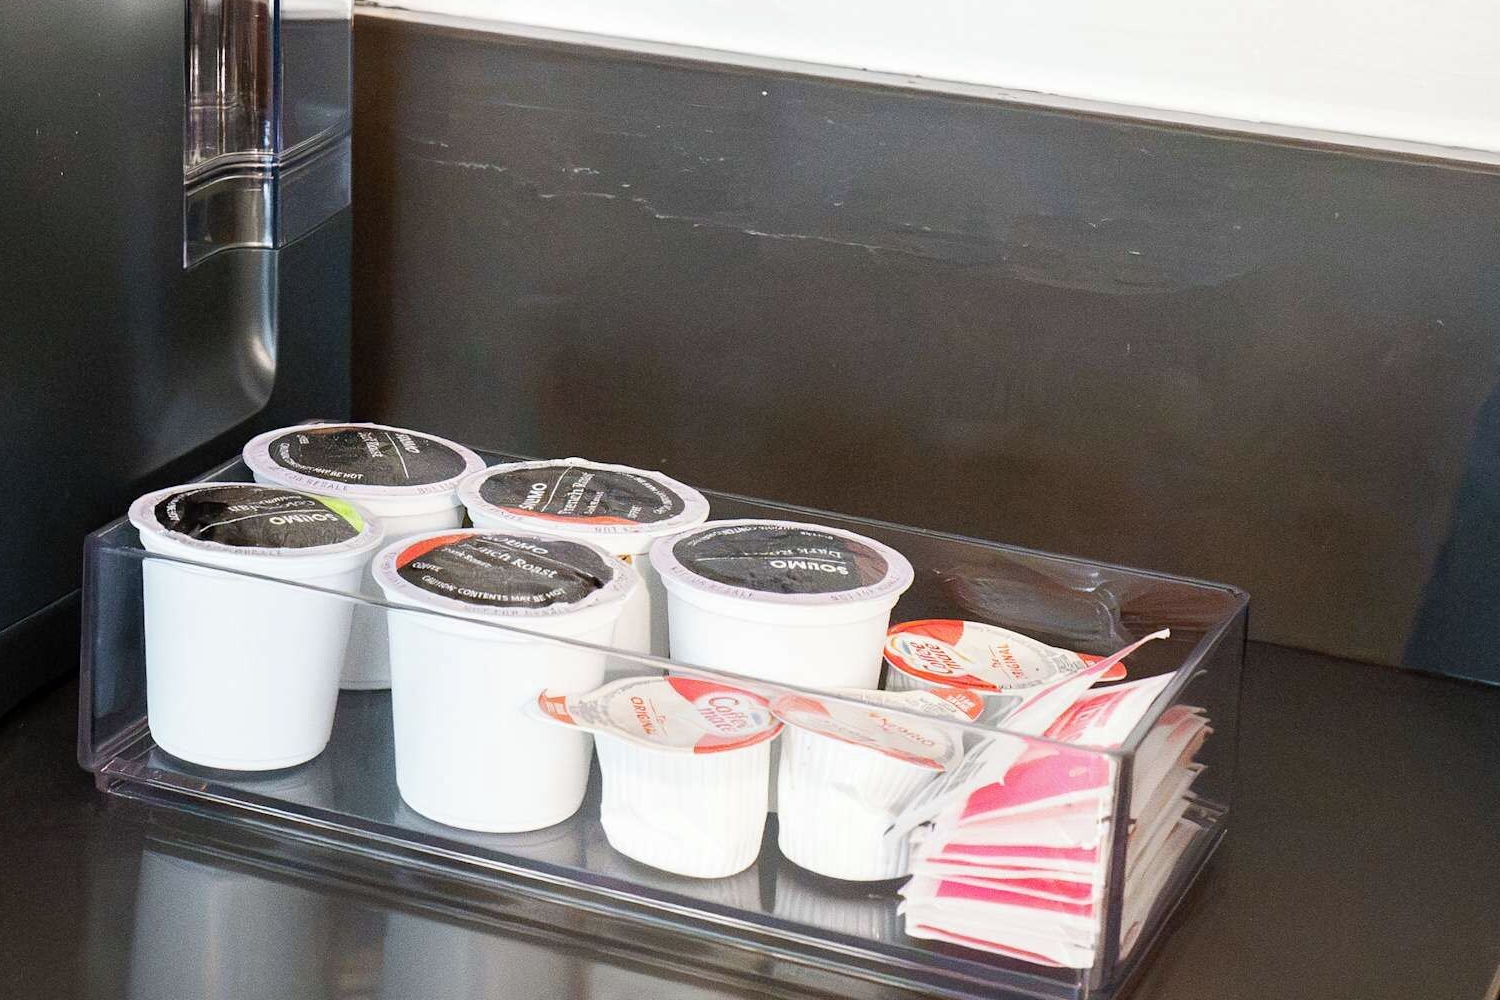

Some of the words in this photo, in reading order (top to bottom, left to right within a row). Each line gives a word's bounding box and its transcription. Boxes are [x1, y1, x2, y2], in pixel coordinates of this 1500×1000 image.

[512, 557, 558, 579] Roast
[457, 588, 509, 602] CONTENTS
[532, 594, 545, 603] BE
[545, 588, 567, 600] HOT
